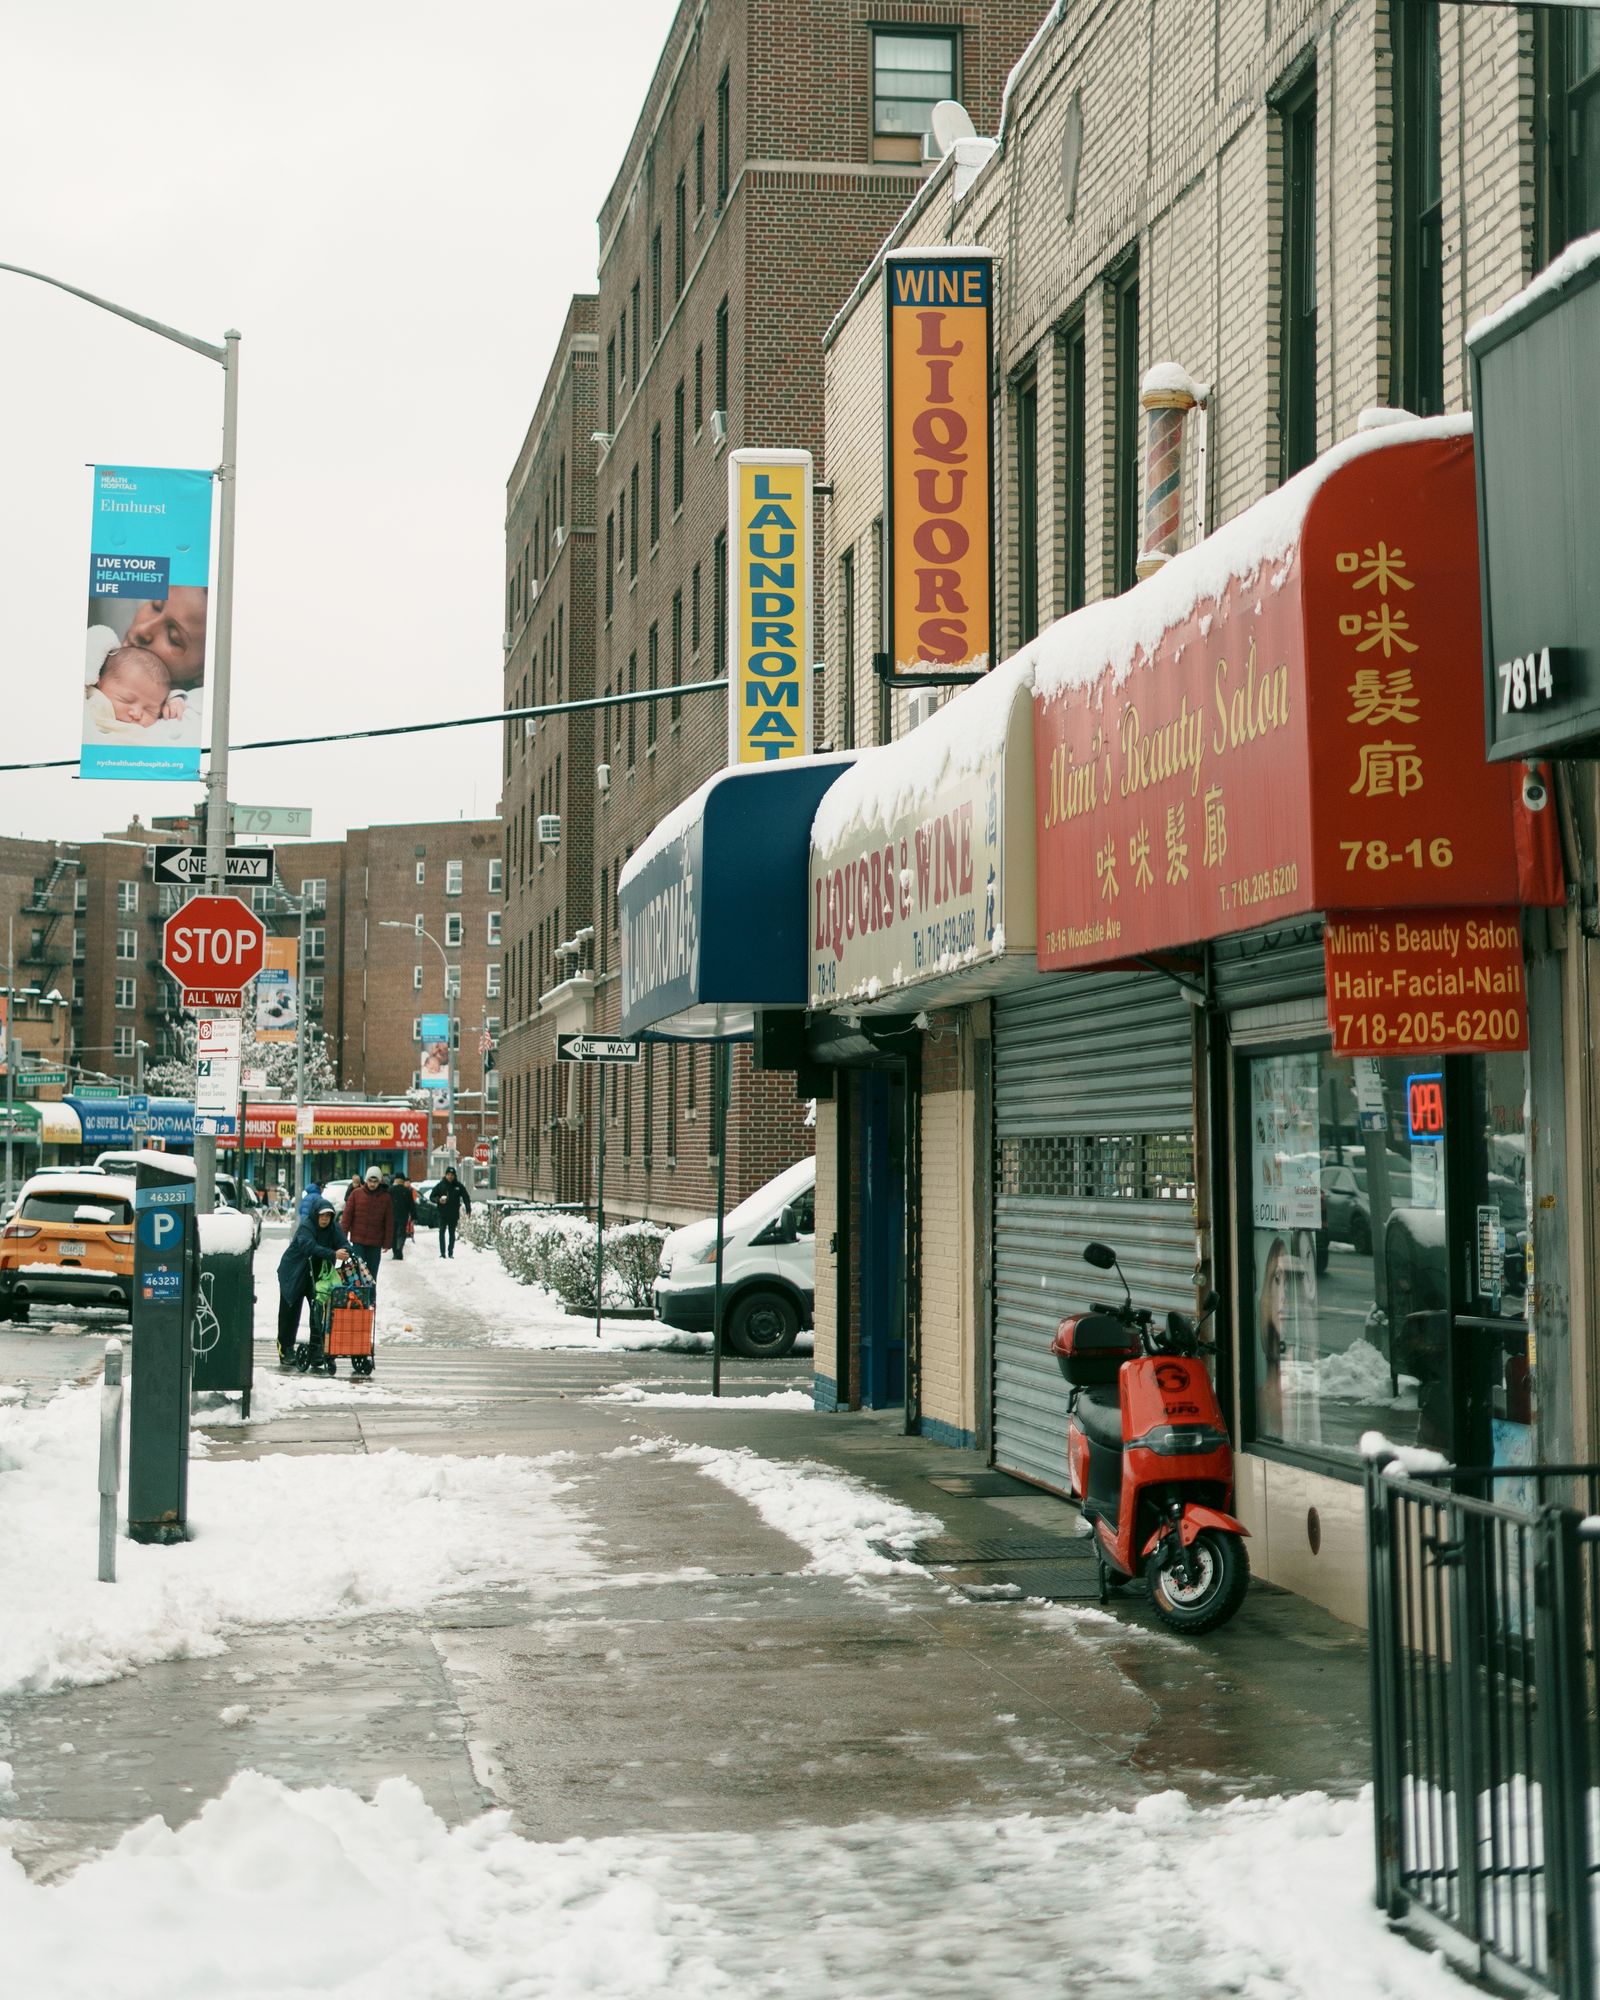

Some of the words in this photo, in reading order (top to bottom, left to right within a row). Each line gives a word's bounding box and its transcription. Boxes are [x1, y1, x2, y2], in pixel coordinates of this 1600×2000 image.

[895, 269, 983, 304] WINE
[101, 482, 138, 490] HOSPITALS
[912, 311, 970, 662] LIQUORS
[101, 498, 166, 514] Elmhurst
[96, 570, 164, 583] HEALTHIEST
[97, 558, 121, 568] LIVE
[123, 560, 156, 570] YOUR
[96, 583, 119, 593] LIFE
[745, 474, 800, 760] LAUNDROMAT
[1336, 540, 1424, 798] 咪咪髮廊
[1498, 645, 1553, 715] 7814
[1044, 724, 1112, 830] Mimi's
[1119, 693, 1206, 800] Beauty
[1214, 636, 1292, 756] Salon
[241, 809, 272, 832] 79
[287, 811, 302, 823] ST
[178, 858, 207, 873] ONE
[226, 859, 261, 875] WAY
[1339, 838, 1454, 871] 78-16
[815, 841, 894, 962] LIQUORS
[914, 800, 974, 914] WINE
[1219, 885, 1230, 911] T.
[1231, 863, 1299, 910] 718.205.6200
[171, 927, 257, 965] STOP
[630, 873, 693, 1006] LAUNDROMAT
[1046, 931, 1067, 954] 78-16
[1067, 919, 1105, 949] Woodside
[1105, 915, 1121, 941] Ave
[1330, 923, 1390, 954] Mimi's
[1395, 922, 1460, 958] Beauty
[1466, 920, 1520, 950] Salon
[817, 961, 837, 995] 78-18
[1334, 965, 1521, 999] Hair-Facial-Nail
[187, 992, 209, 1004] ALL
[215, 992, 238, 1005] WAY
[1339, 1009, 1520, 1046] 718-205-6200
[573, 1042, 596, 1054] ONE
[607, 1043, 632, 1054] WAY
[200, 1061, 208, 1076] 2
[81, 1089, 112, 1097] Broadway
[96, 1116, 119, 1129] SUPER
[326, 1125, 331, 1135] &
[333, 1125, 376, 1136] HOUSEHOLD
[377, 1126, 391, 1136] INC.
[150, 1191, 186, 1202] 463231
[154, 1213, 175, 1245] P
[145, 1277, 179, 1286] 463231
